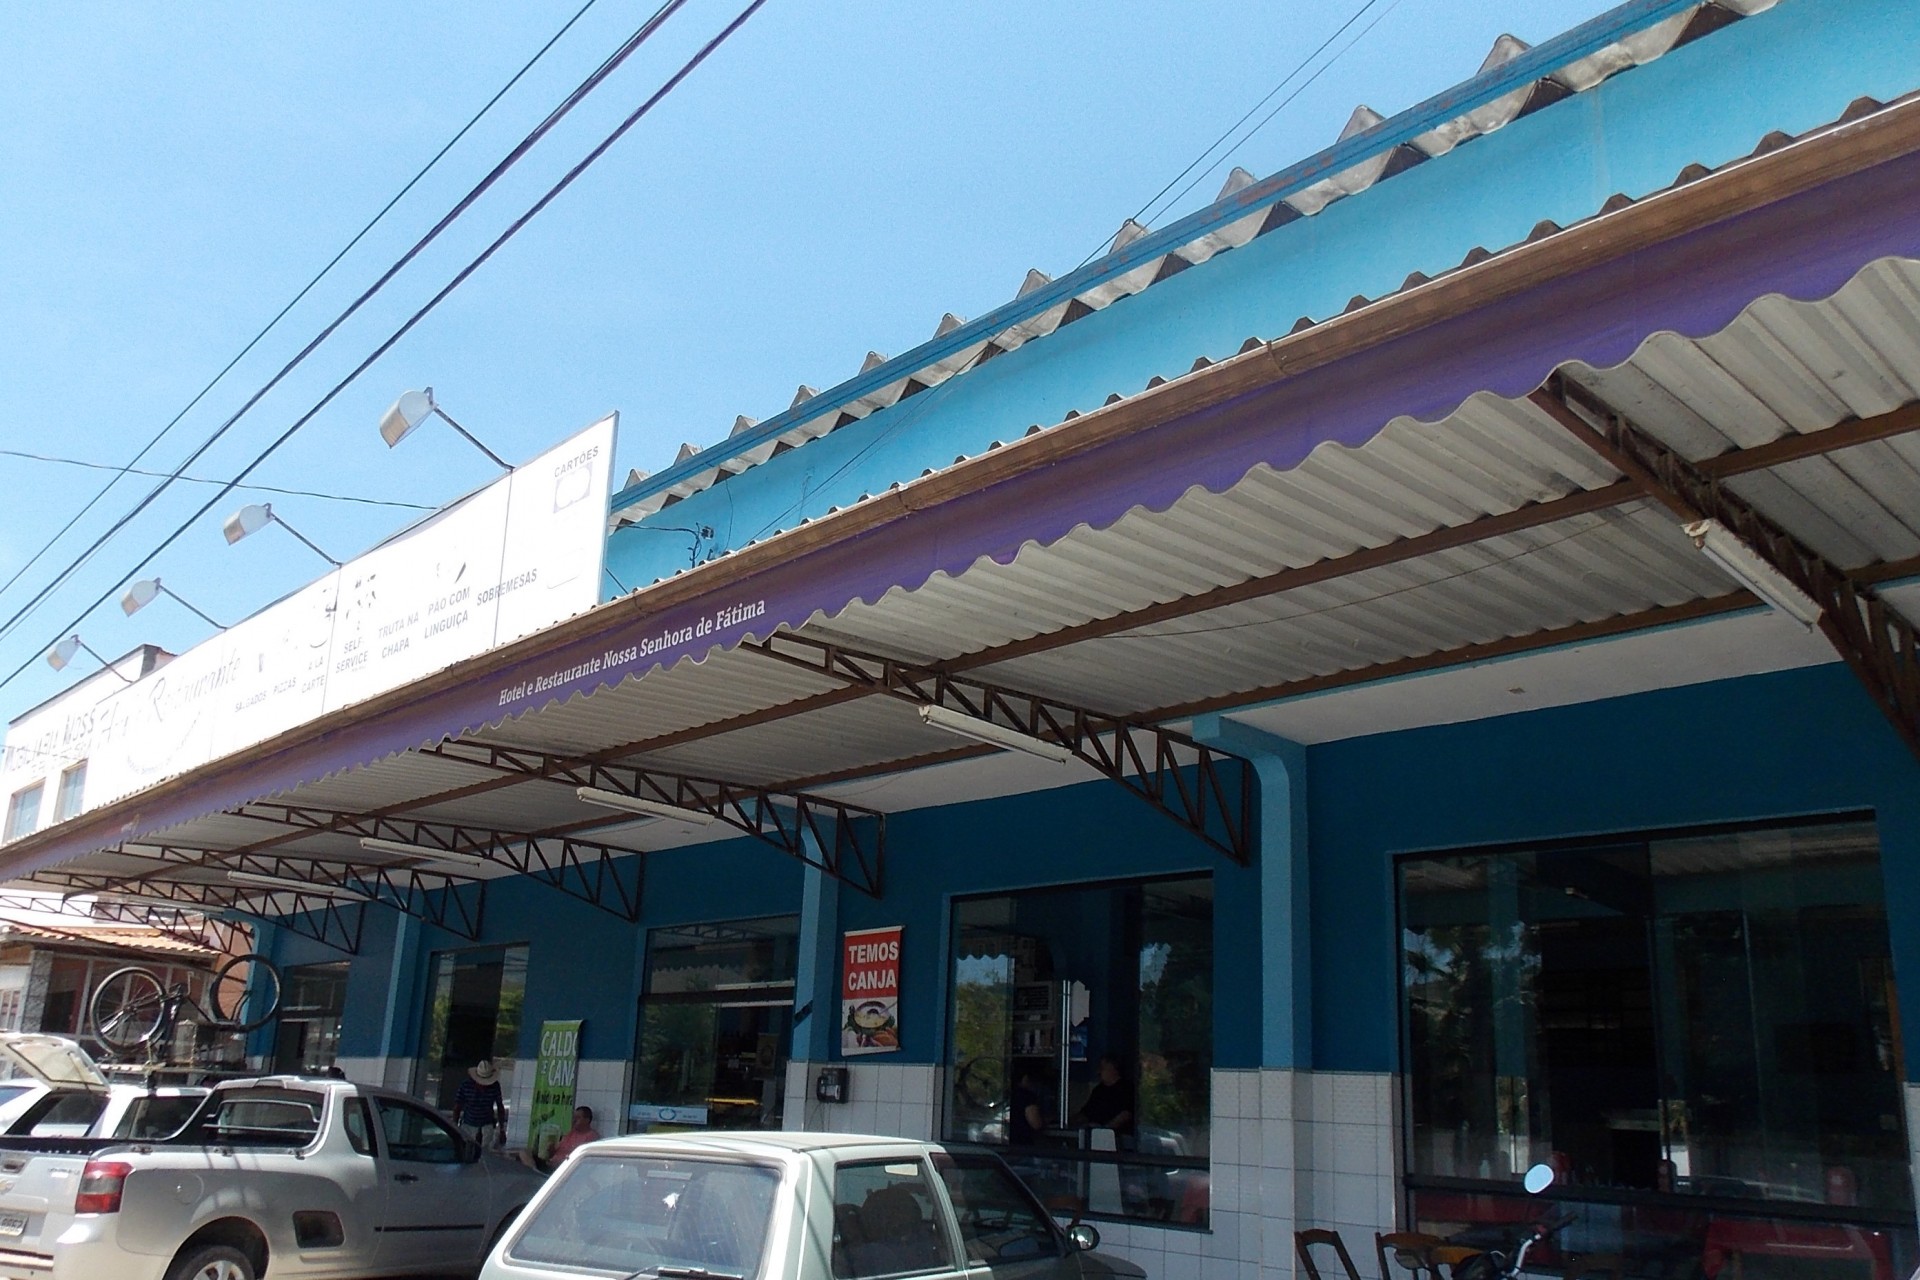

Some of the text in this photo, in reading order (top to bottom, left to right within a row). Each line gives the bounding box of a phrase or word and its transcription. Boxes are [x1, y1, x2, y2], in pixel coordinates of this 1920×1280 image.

[554, 445, 599, 478] CARTÕES
[449, 586, 471, 607] COM
[476, 568, 538, 607] SOBREMESAS
[378, 611, 420, 639] TRUTA NA
[424, 609, 468, 640] LINGUIÇA
[382, 637, 410, 659] CHAPA
[498, 599, 766, 706] Hotel e Restaurante Nossa Senhora de Fátima
[336, 650, 369, 674] SERVICE
[302, 674, 325, 694] CARTE
[848, 941, 899, 964] TEMOS
[848, 969, 897, 991] CANJA
